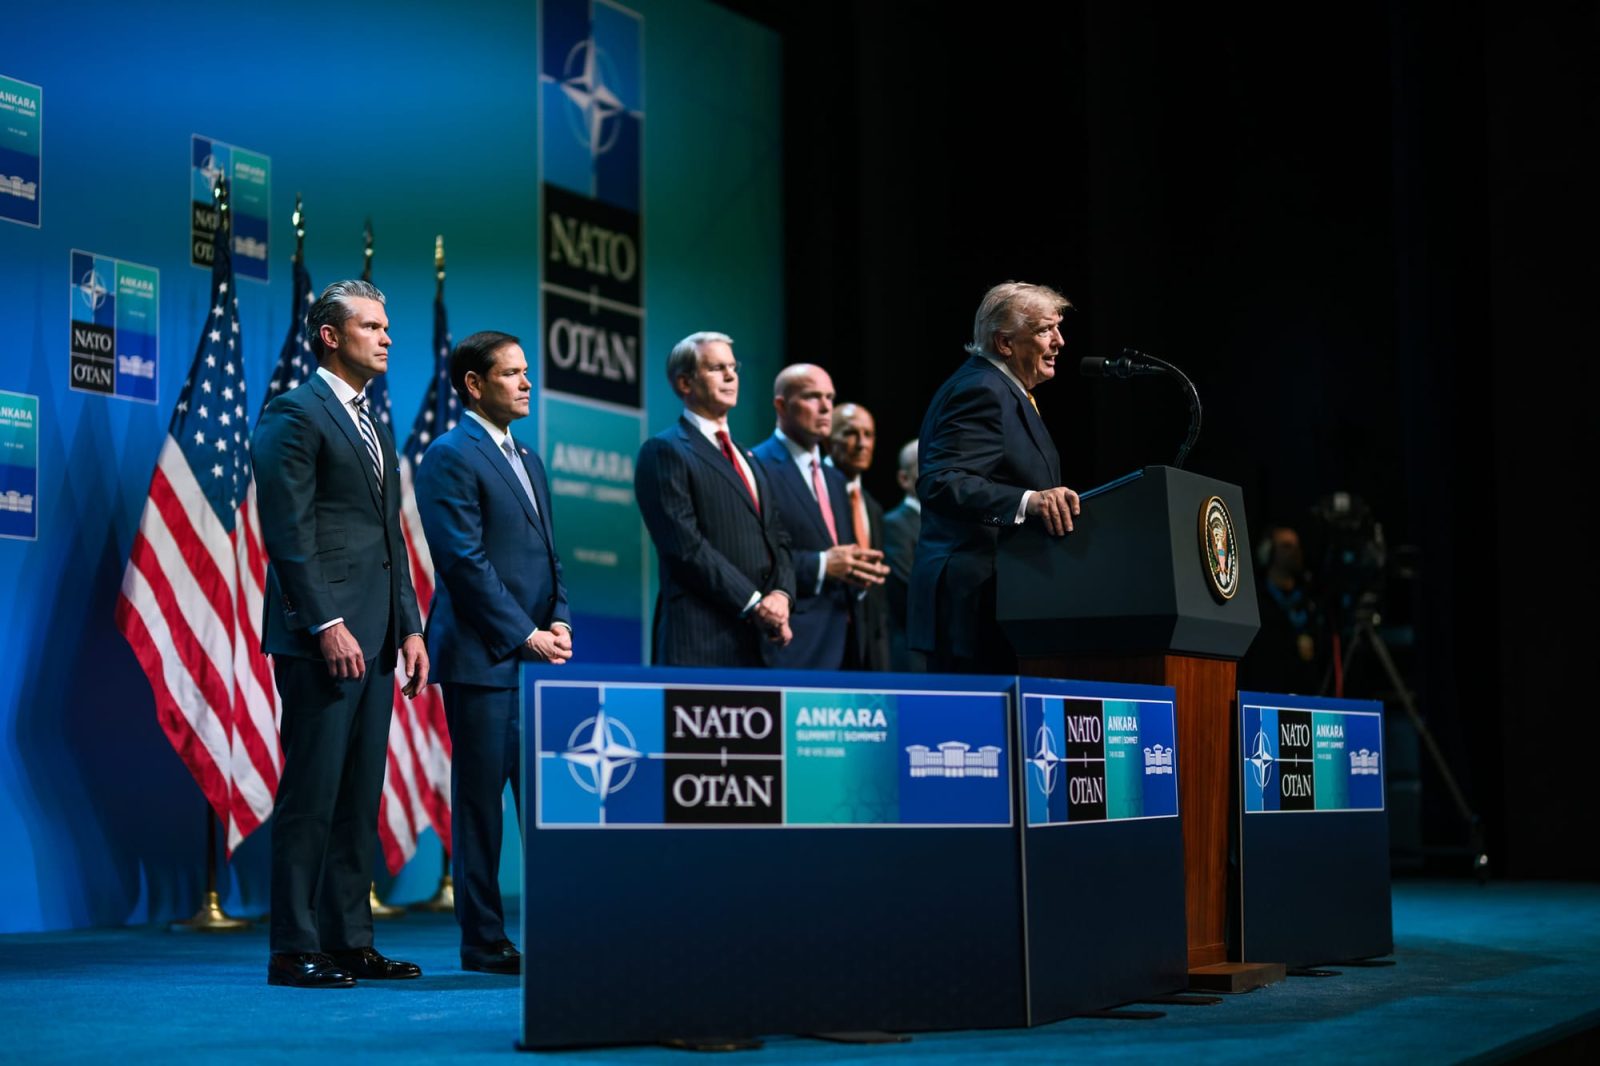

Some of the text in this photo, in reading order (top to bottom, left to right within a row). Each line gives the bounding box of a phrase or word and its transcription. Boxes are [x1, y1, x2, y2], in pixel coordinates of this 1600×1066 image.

[549, 212, 636, 282] NATO
[74, 329, 112, 351] NATO
[549, 318, 636, 383] OTAN
[73, 363, 112, 386] OTAN
[0, 406, 33, 421] NKARA
[551, 442, 634, 483] ANKARA
[672, 705, 773, 739] NATO
[795, 706, 888, 728] ANKARA
[1067, 715, 1101, 743] NATO
[1107, 715, 1138, 731] ANKARA
[844, 731, 887, 743] SOMMET
[1280, 723, 1310, 747] NATO
[1316, 724, 1344, 739] ANKARA
[672, 774, 774, 807] OTAN
[1069, 776, 1103, 805] OTAN
[1281, 773, 1311, 797] OTAN
